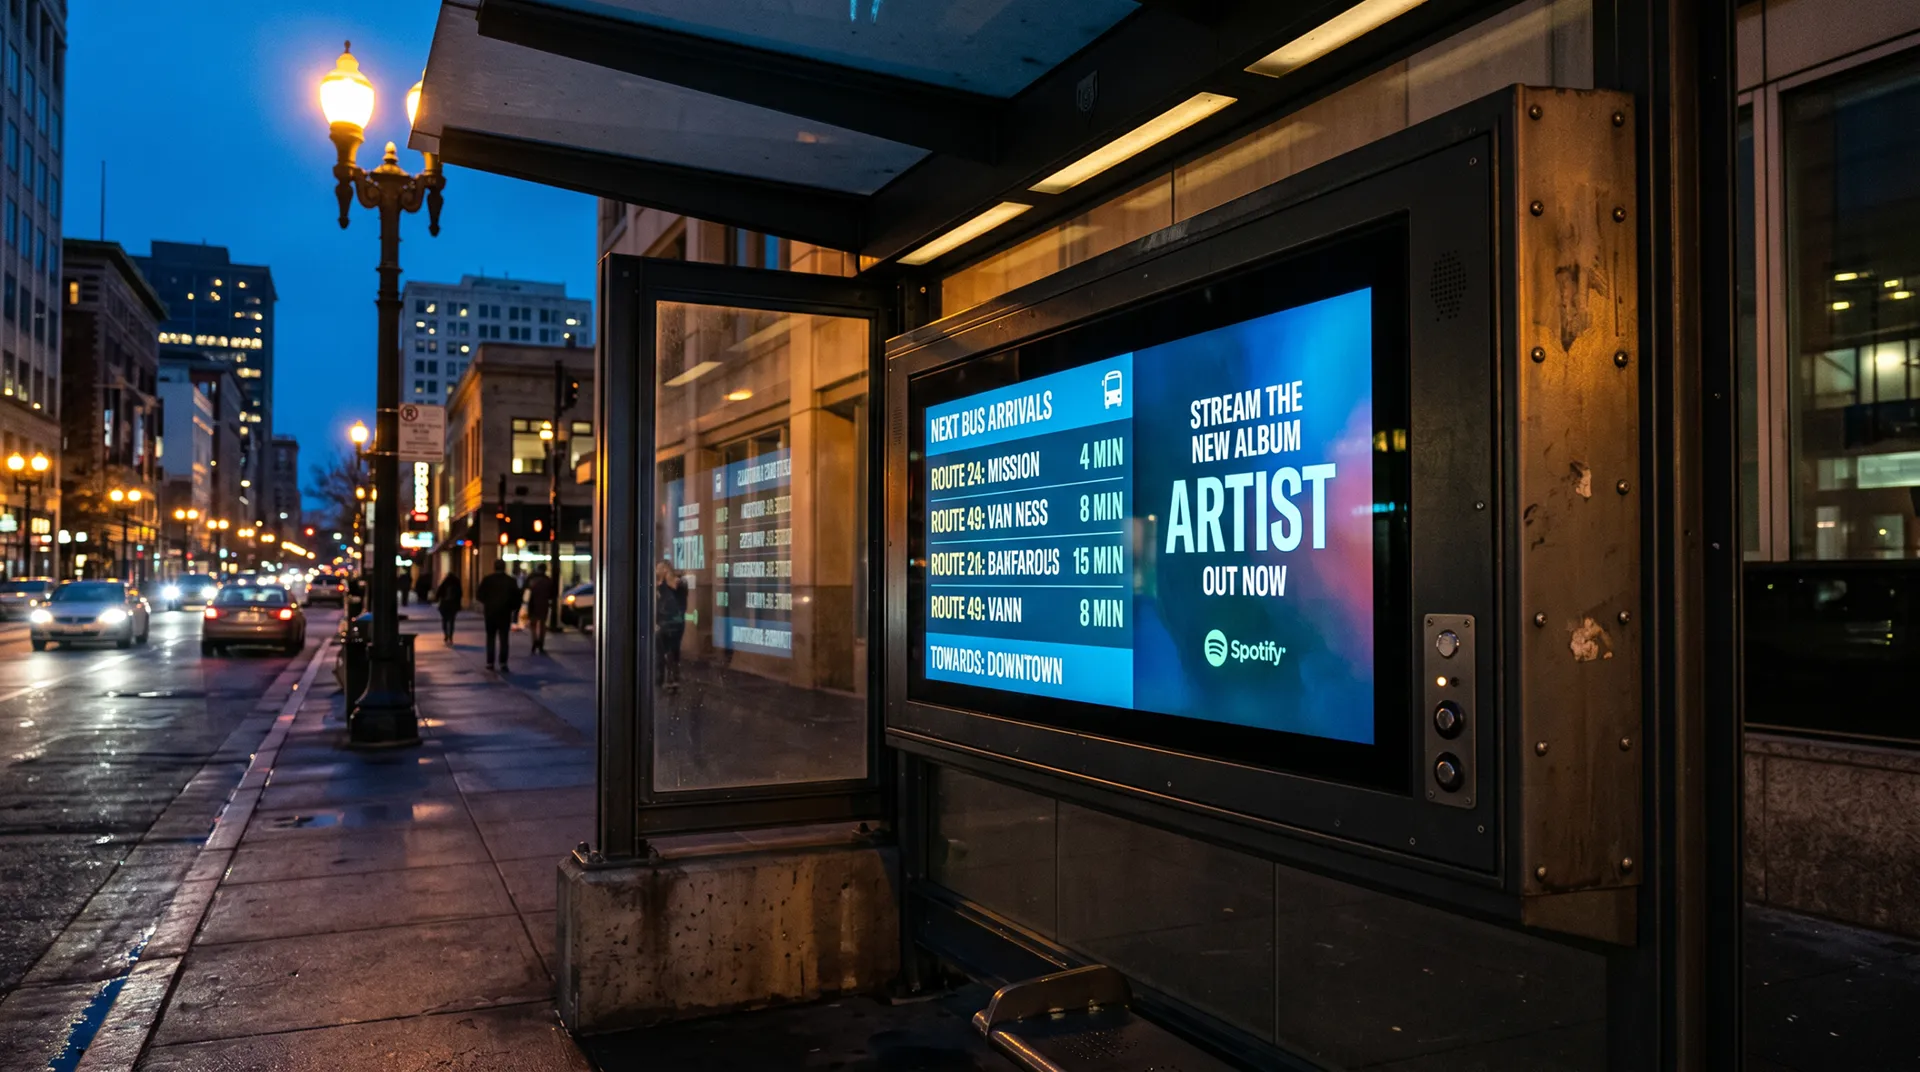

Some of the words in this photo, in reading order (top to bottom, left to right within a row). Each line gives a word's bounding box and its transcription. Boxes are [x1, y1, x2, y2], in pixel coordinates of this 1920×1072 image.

[931, 413, 960, 443] NEXT
[961, 406, 985, 437] BUS
[987, 390, 1053, 432] ARRIVALS
[1190, 388, 1261, 430] STREAM
[1265, 380, 1303, 416] THE
[1079, 442, 1090, 470] 4
[1093, 436, 1124, 469] MIN
[1192, 430, 1231, 464] NEW
[1234, 419, 1301, 459] ALBUM
[931, 463, 965, 491] ROUTE
[967, 461, 985, 486] 24:
[987, 450, 1040, 483] MISSION
[931, 507, 965, 533] ROUTE
[967, 506, 985, 530] 49:
[987, 502, 1012, 529] VAN
[1015, 498, 1048, 527] NESS
[1079, 494, 1090, 522] 8
[1093, 490, 1124, 521] MIN
[1165, 463, 1336, 554] ARTIST
[931, 552, 965, 576] ROUTE
[1073, 547, 1089, 575] 15
[1093, 545, 1124, 574] MIN
[1202, 565, 1238, 596] OUT
[1242, 565, 1287, 597] NOW
[931, 595, 965, 619] ROUTE
[967, 596, 986, 621] 49:
[987, 596, 1022, 623] VANN
[1079, 598, 1090, 627] 8
[1093, 599, 1124, 628] MIN
[930, 645, 985, 676] TOWARDS:
[987, 650, 1063, 685] DOWNTOWN
[1230, 639, 1283, 667] Spotify
